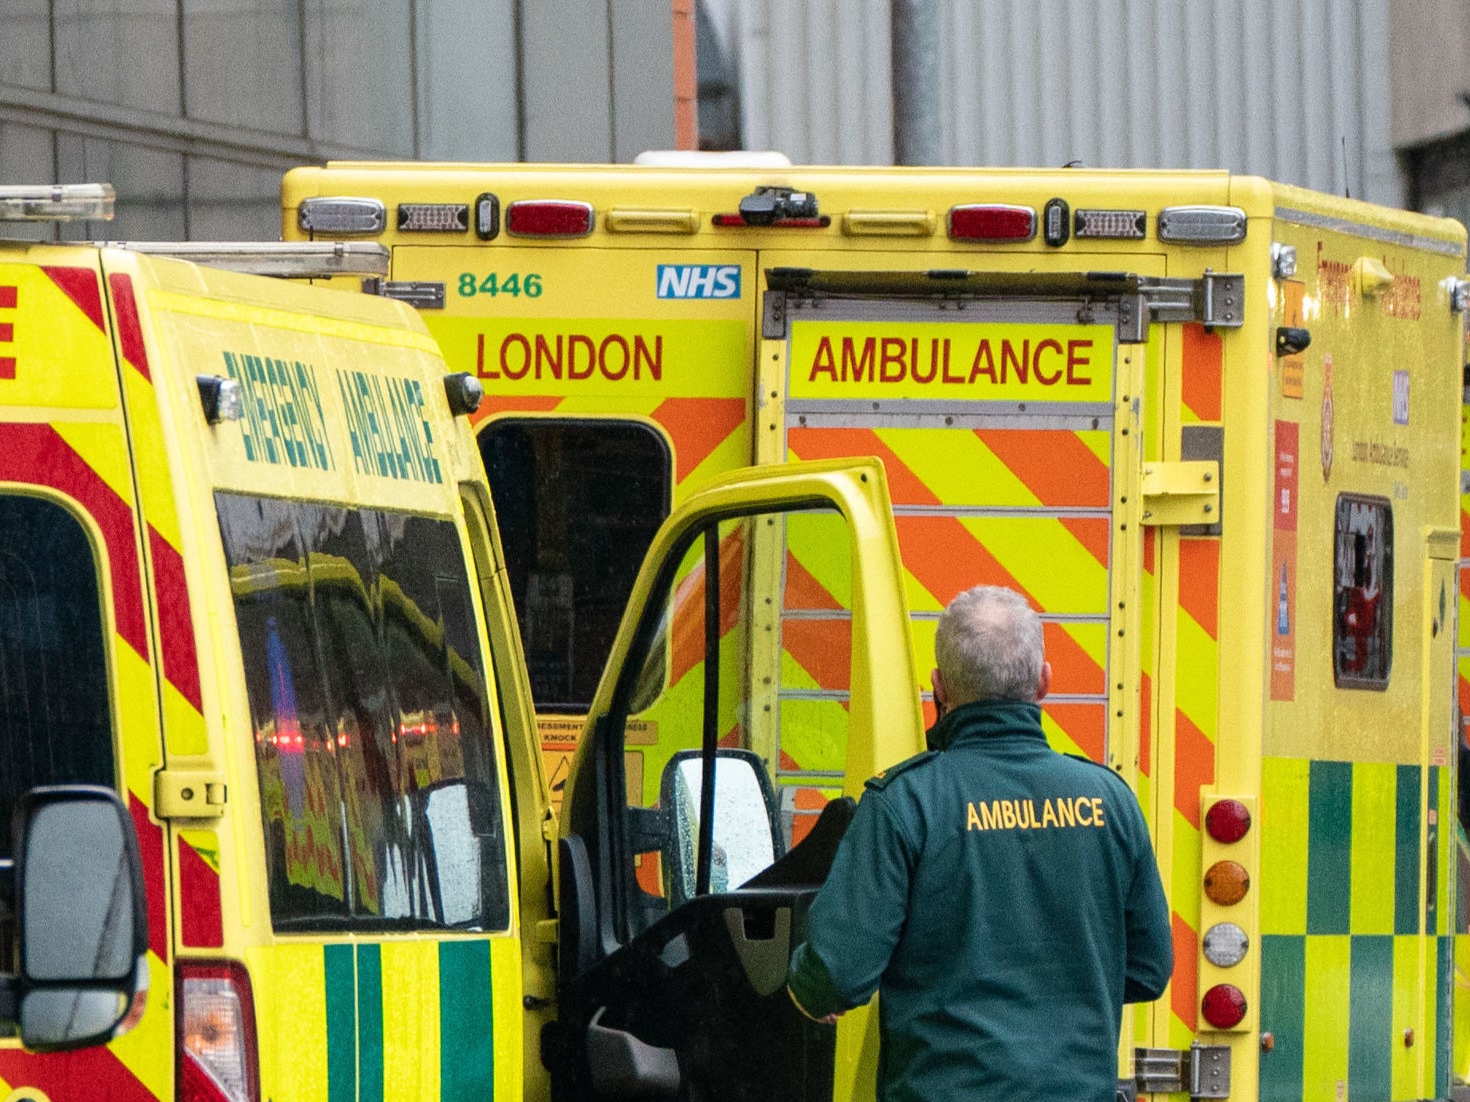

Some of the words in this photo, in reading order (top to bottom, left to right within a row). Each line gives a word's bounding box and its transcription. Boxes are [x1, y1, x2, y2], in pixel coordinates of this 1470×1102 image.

[458, 272, 543, 298] 8446
[658, 266, 739, 298] NHS
[476, 332, 663, 381] LONDON
[808, 336, 1094, 386] AMBULANCE
[967, 796, 1105, 831] AMBULANCE
